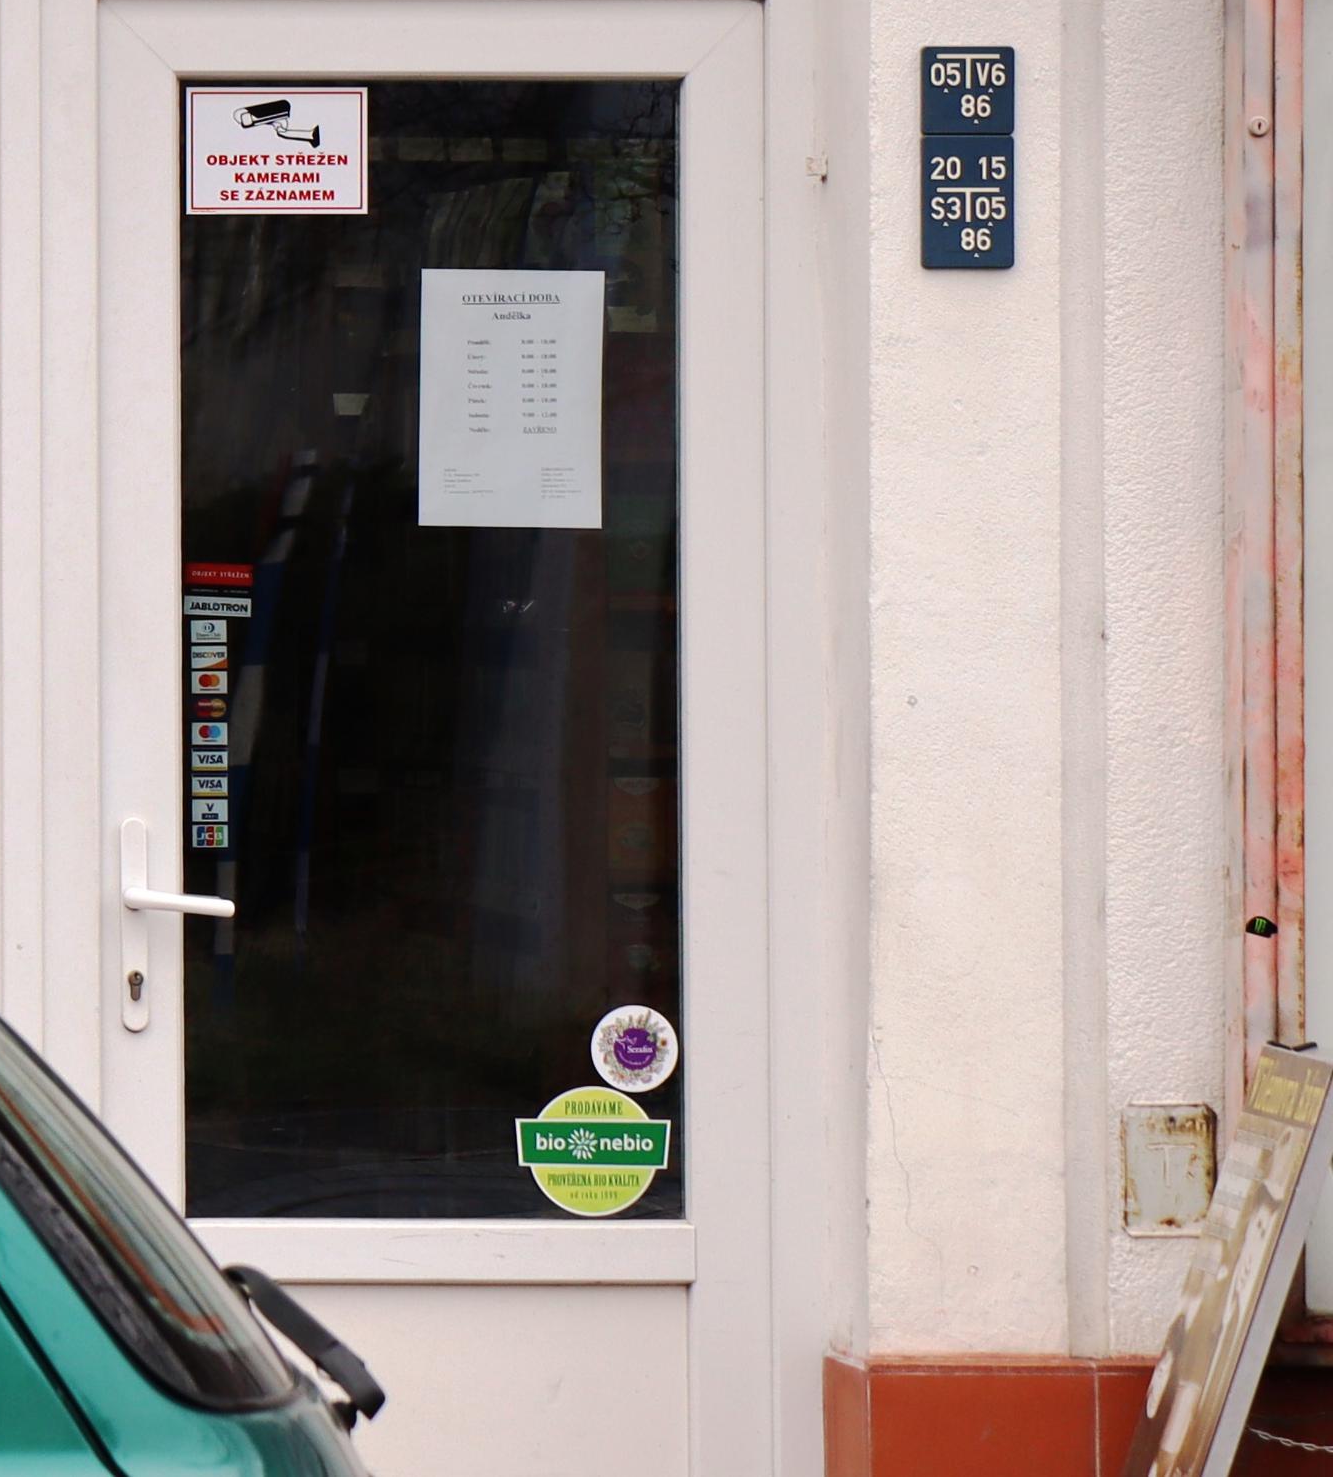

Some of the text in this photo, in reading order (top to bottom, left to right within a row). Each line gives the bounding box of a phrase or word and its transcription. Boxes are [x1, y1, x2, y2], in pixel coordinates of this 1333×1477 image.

[975, 62, 1006, 87] V6
[960, 94, 991, 118] 86
[206, 152, 349, 166] OBJEKT STŘEŽEN
[930, 156, 1006, 181] 20 15
[234, 172, 320, 184] KAMERAMI
[220, 187, 336, 201] SE ZÁZNAMEM
[930, 196, 1006, 221] S3 05
[960, 228, 991, 252] 86
[462, 292, 561, 303] OTEVÍRACÍ DOBA
[492, 310, 531, 321] Andělka
[190, 602, 249, 613] JABLOTRON
[192, 651, 226, 659] DISCOVER
[197, 754, 224, 764] VISA
[197, 779, 223, 788] VISA
[197, 832, 223, 841] JCB
[564, 1101, 623, 1115] PRODÁVÁME
[536, 1133, 654, 1152] bio nebio
[547, 1173, 640, 1186] PROVĚŘENÁ BIO KVALITA
